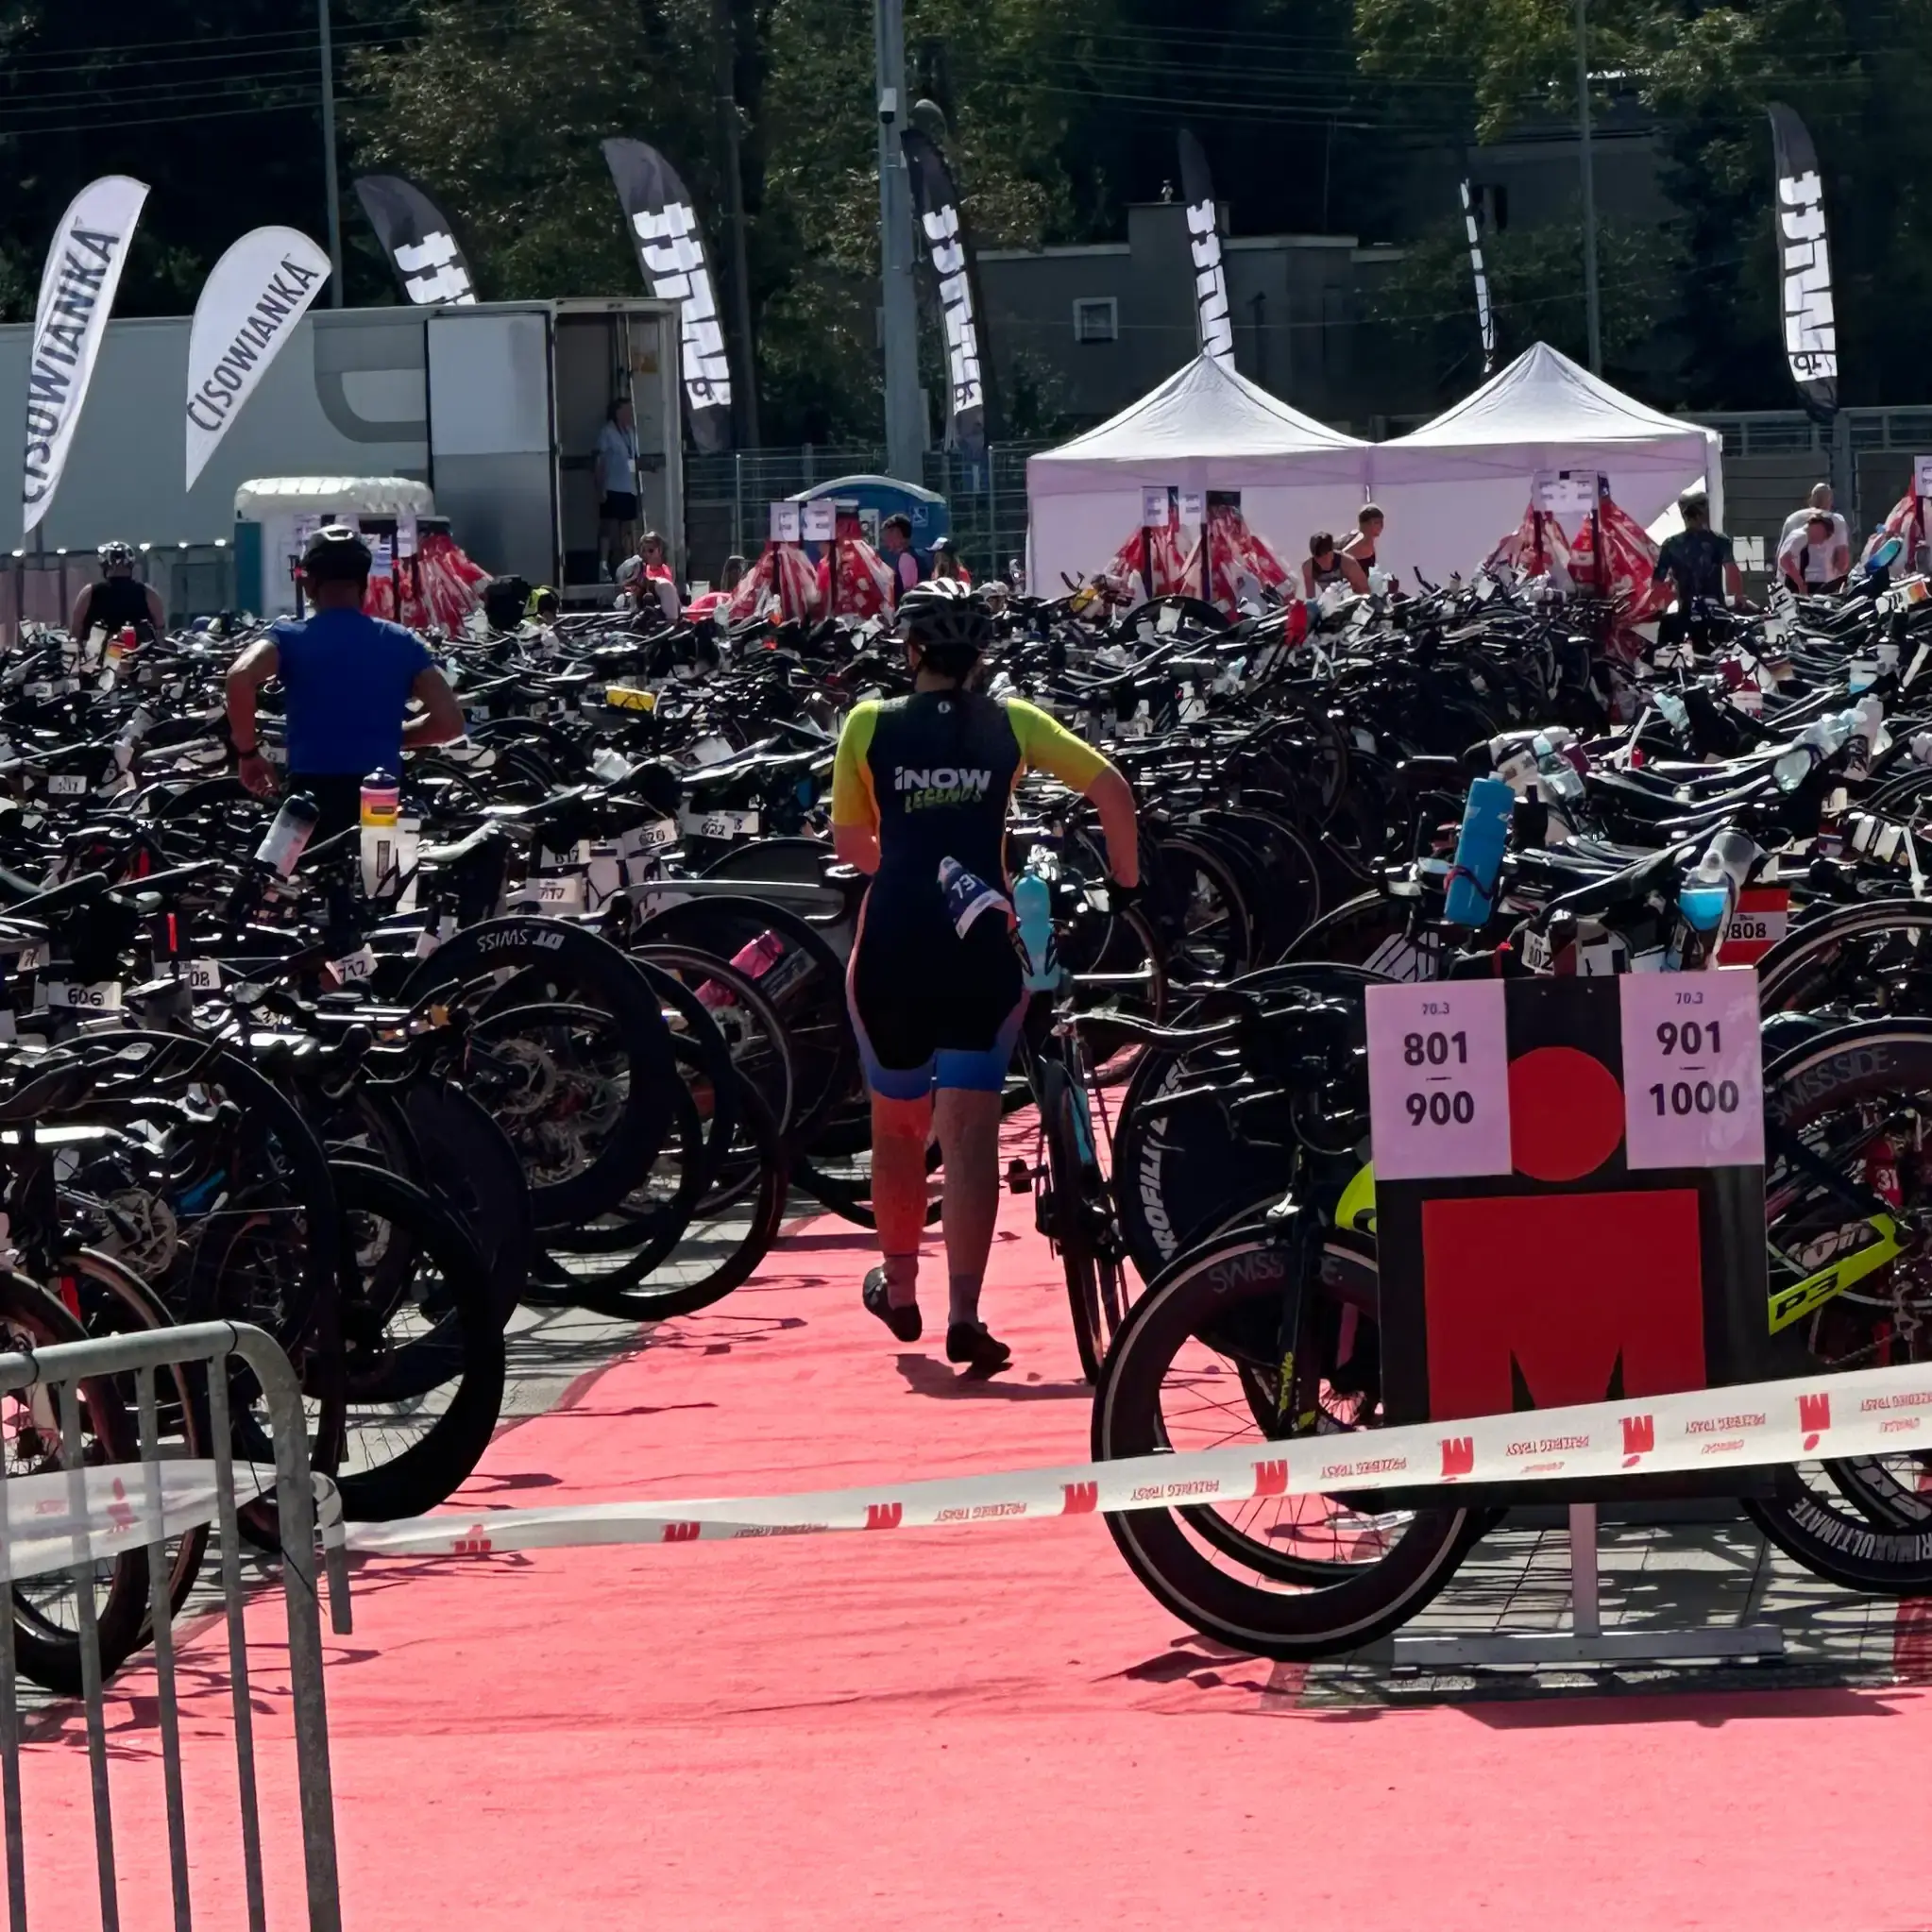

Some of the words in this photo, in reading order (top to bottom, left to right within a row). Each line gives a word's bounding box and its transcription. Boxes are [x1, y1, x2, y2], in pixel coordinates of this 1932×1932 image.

[187, 258, 319, 432] CISOWIANKA
[476, 928, 533, 954] SWISS
[1730, 922, 1767, 940] 808
[67, 988, 105, 1007] 606
[1422, 1002, 1450, 1016] 70.3
[1674, 991, 1704, 1006] 70.3
[1403, 1031, 1467, 1067] 801
[1656, 1020, 1722, 1057] 901
[1405, 1091, 1475, 1127] 900
[1649, 1079, 1740, 1117] 1000
[1774, 1272, 1839, 1320] P3
[1788, 1497, 1877, 1560] ULTIMATE
